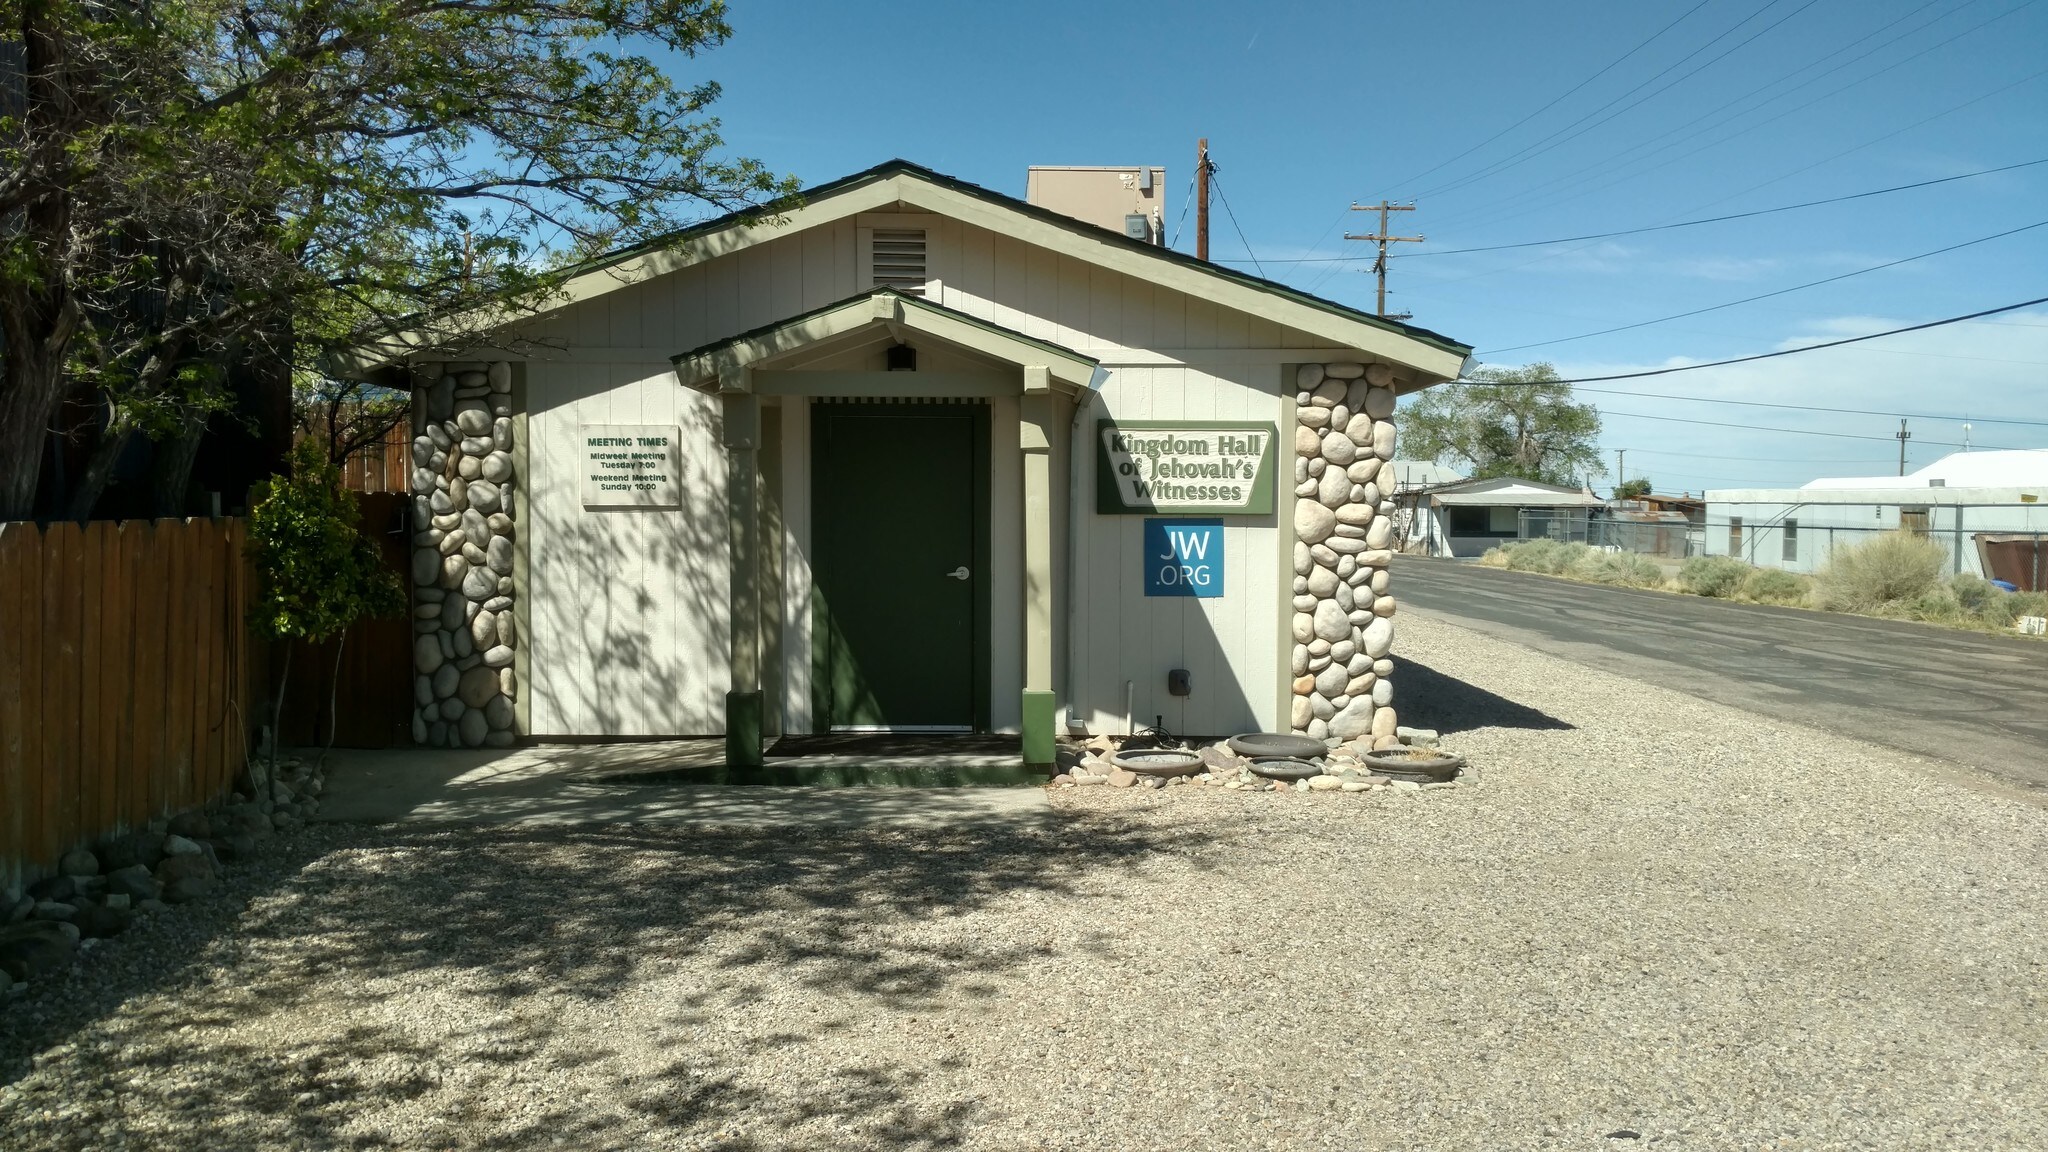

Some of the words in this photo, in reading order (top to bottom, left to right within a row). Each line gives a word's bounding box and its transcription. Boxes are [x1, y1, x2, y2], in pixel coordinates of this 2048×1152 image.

[588, 438, 632, 446] MEETING
[637, 438, 668, 446] TIMES
[1111, 434, 1210, 458] Kingdom
[1218, 435, 1261, 456] Hall
[631, 453, 666, 461] Meeting
[602, 461, 635, 469] Tuesday
[639, 461, 656, 469] 7:00
[1119, 458, 1143, 476] of
[1150, 458, 1254, 481] Jehovah's
[632, 475, 667, 483] Meeting
[601, 483, 632, 491] Sunday
[1132, 480, 1242, 501] Witnesses
[1160, 531, 1211, 561] JW
[1156, 565, 1211, 586] .ORG
